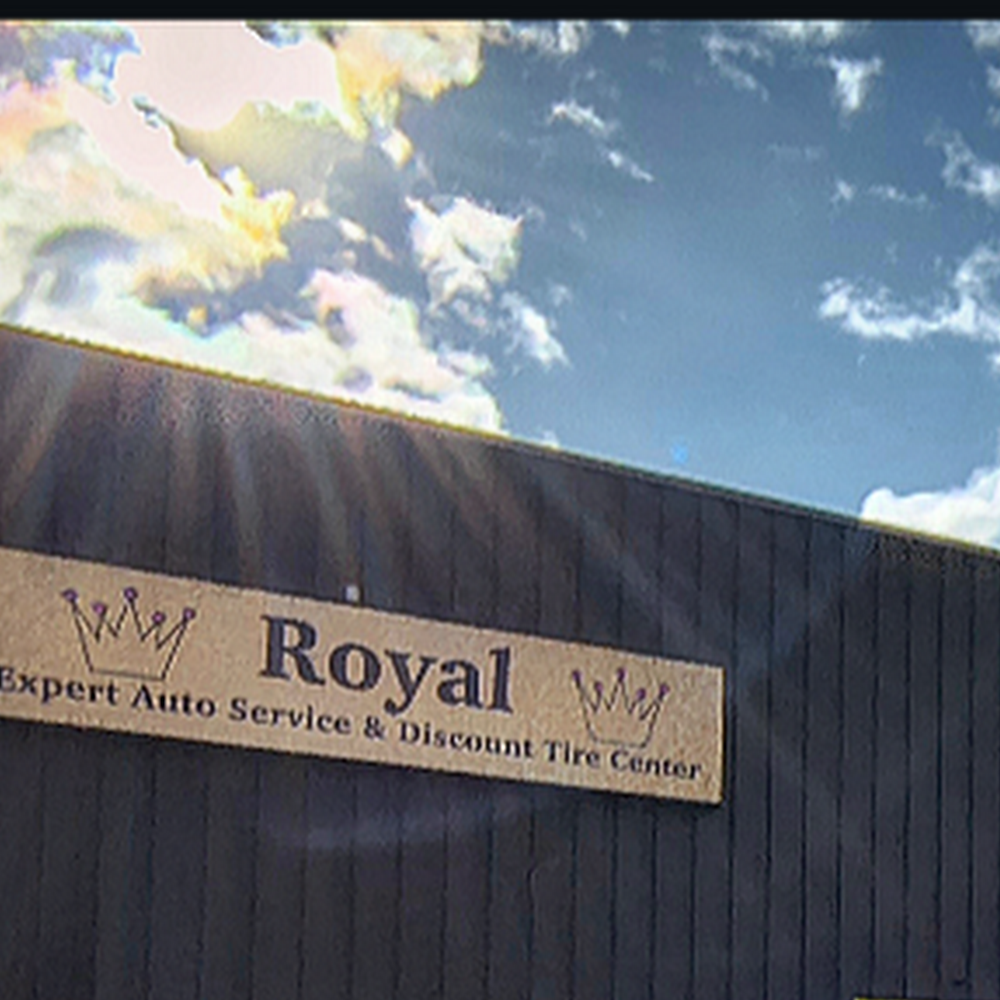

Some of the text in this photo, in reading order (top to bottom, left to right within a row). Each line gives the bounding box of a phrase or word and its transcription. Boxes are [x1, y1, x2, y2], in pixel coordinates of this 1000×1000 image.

[259, 615, 513, 714] Royal
[0, 666, 703, 781] Expert Auto Service & Discount Tire Center
